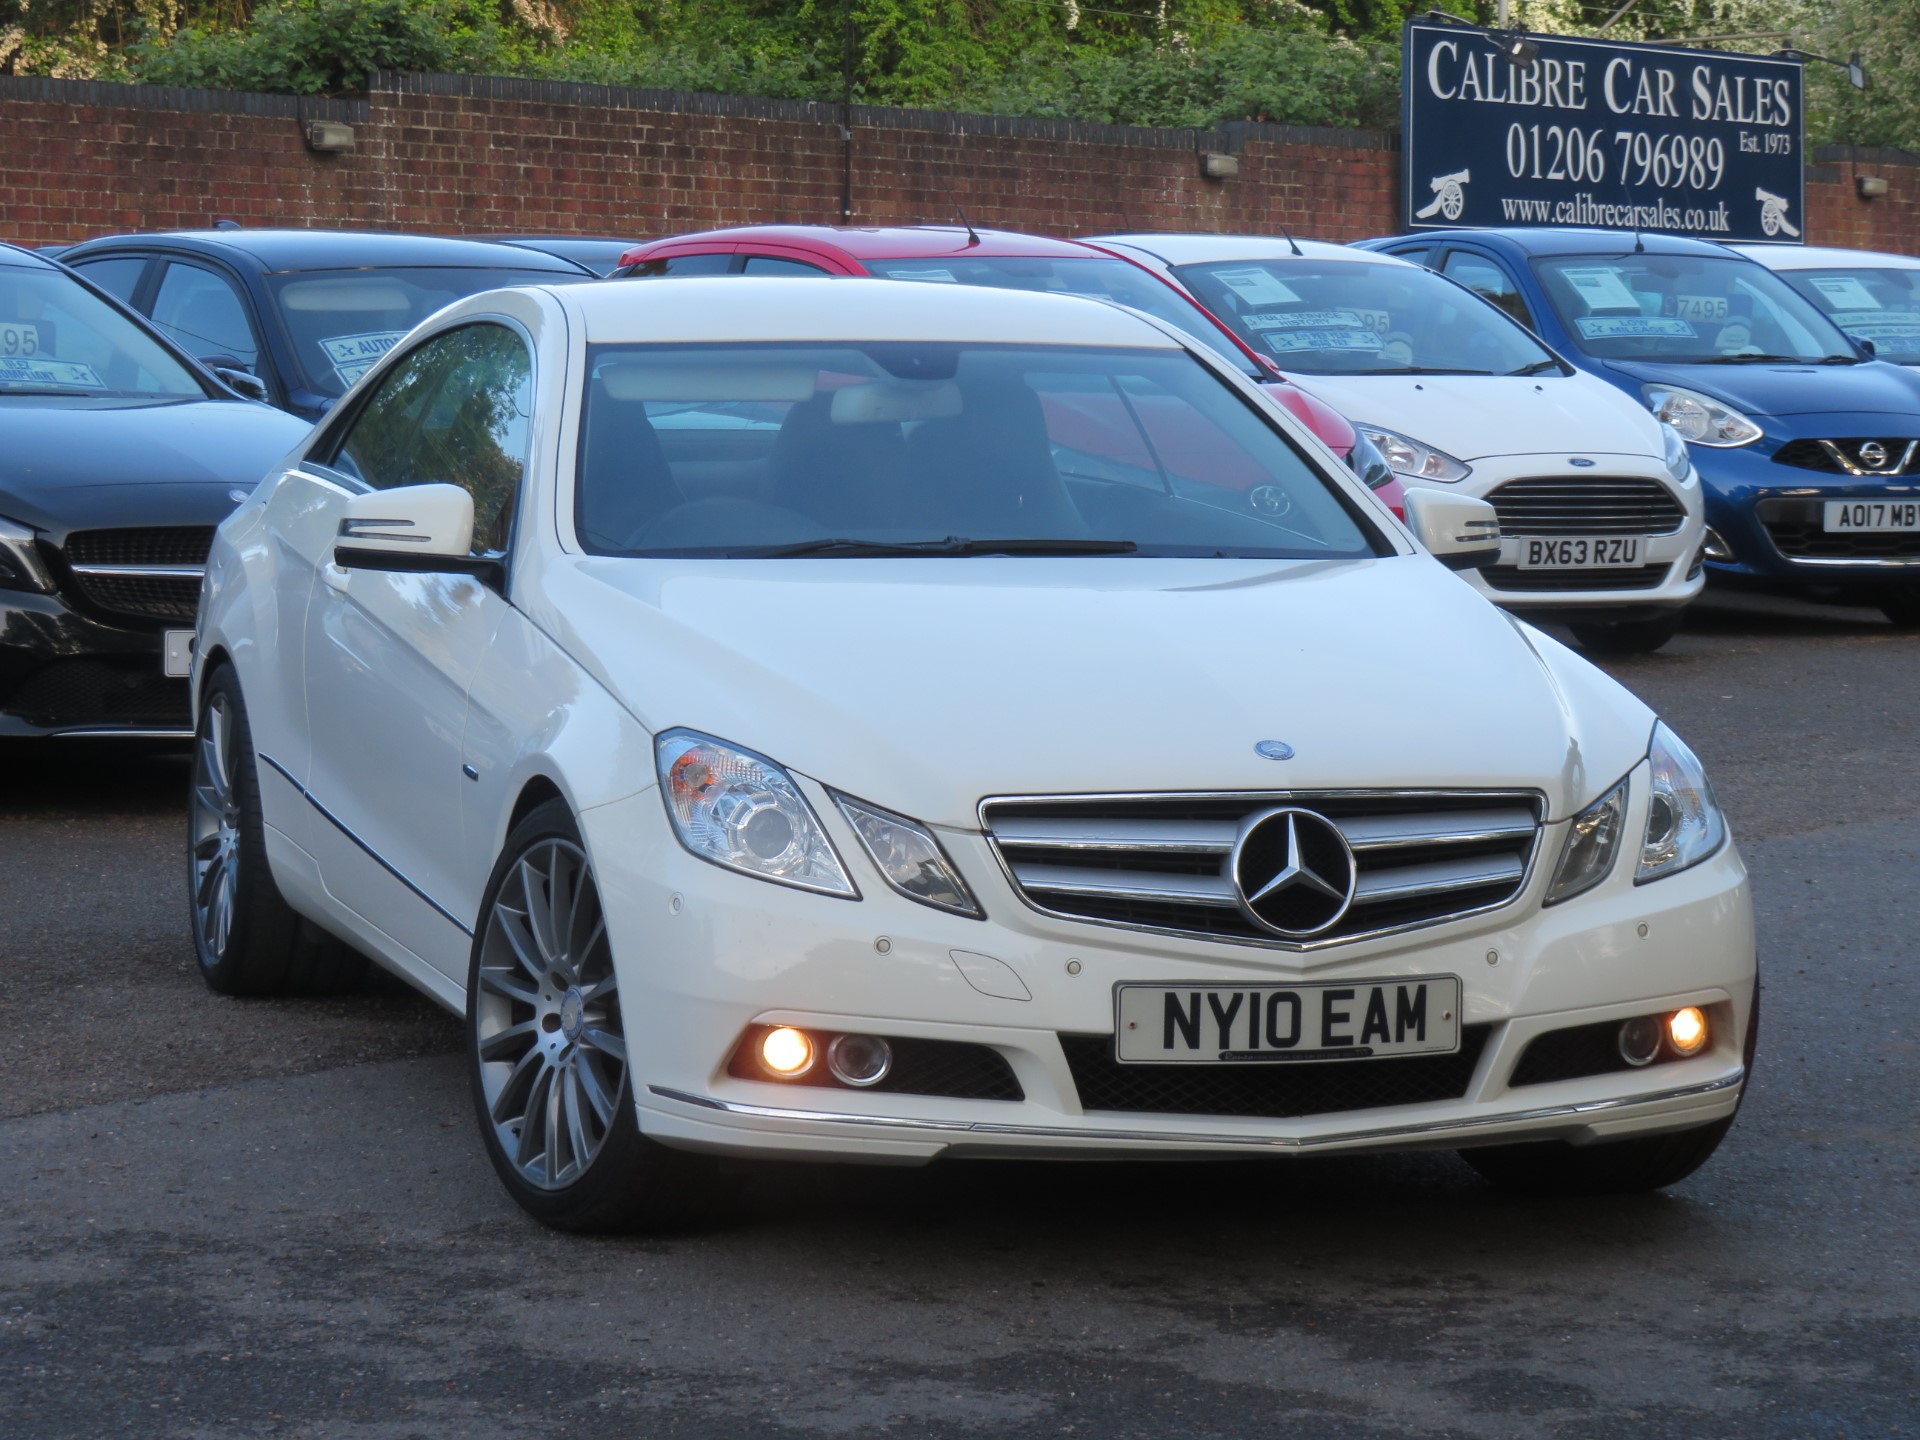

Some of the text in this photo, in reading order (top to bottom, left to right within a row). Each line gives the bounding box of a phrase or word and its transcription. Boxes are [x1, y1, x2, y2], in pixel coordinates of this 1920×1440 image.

[1427, 40, 1791, 127] CALIBRE CAR SALES
[1740, 131, 1791, 155] Est. 1973
[1506, 122, 1724, 191] 01206 796989
[1501, 192, 1730, 232] www.calibrecarsales.co.uk
[1257, 311, 1342, 322] FULL SERVICE
[1279, 318, 1330, 326] HISTORY
[1363, 313, 1389, 335] 95
[1619, 319, 1649, 327] LOW
[1609, 326, 1666, 334] MILEAGE
[3, 328, 37, 356] 95
[0, 368, 57, 381] OMPLIANT
[1839, 504, 1920, 527] AO17 MB
[1528, 539, 1637, 565] BX63 RZU
[1163, 984, 1427, 1050] NY10 EAM
